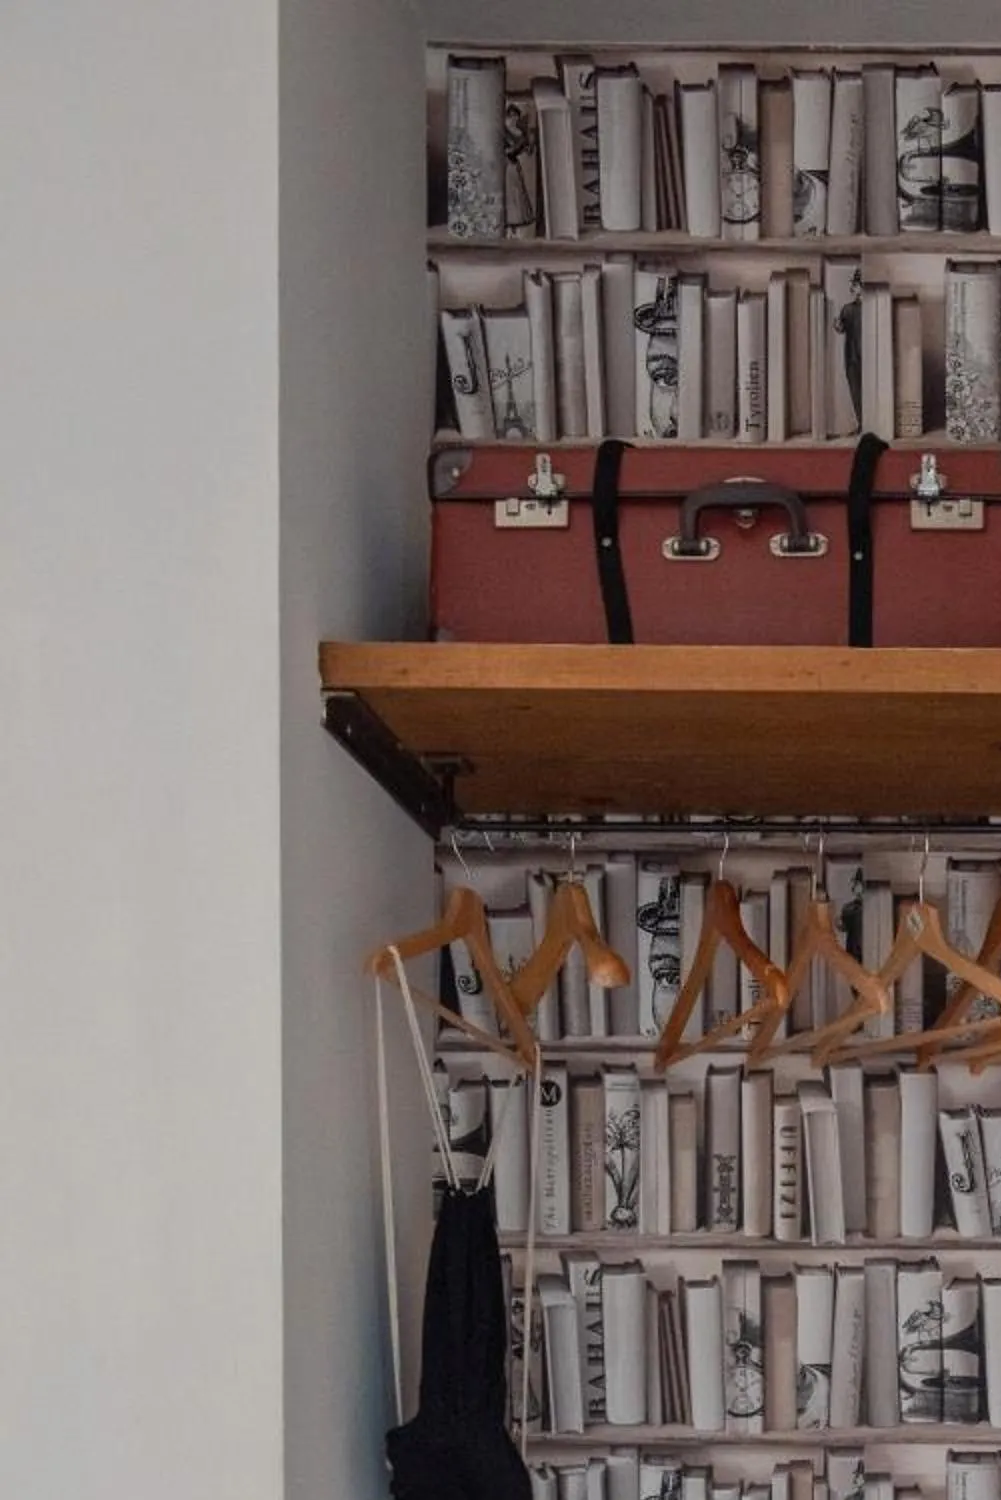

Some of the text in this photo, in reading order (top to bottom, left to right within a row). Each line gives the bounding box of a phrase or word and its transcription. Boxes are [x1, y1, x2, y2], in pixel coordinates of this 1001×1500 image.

[744, 360, 761, 432] Tyrolien
[540, 1082, 562, 1106] M
[780, 1125, 798, 1220] UFFIZI
